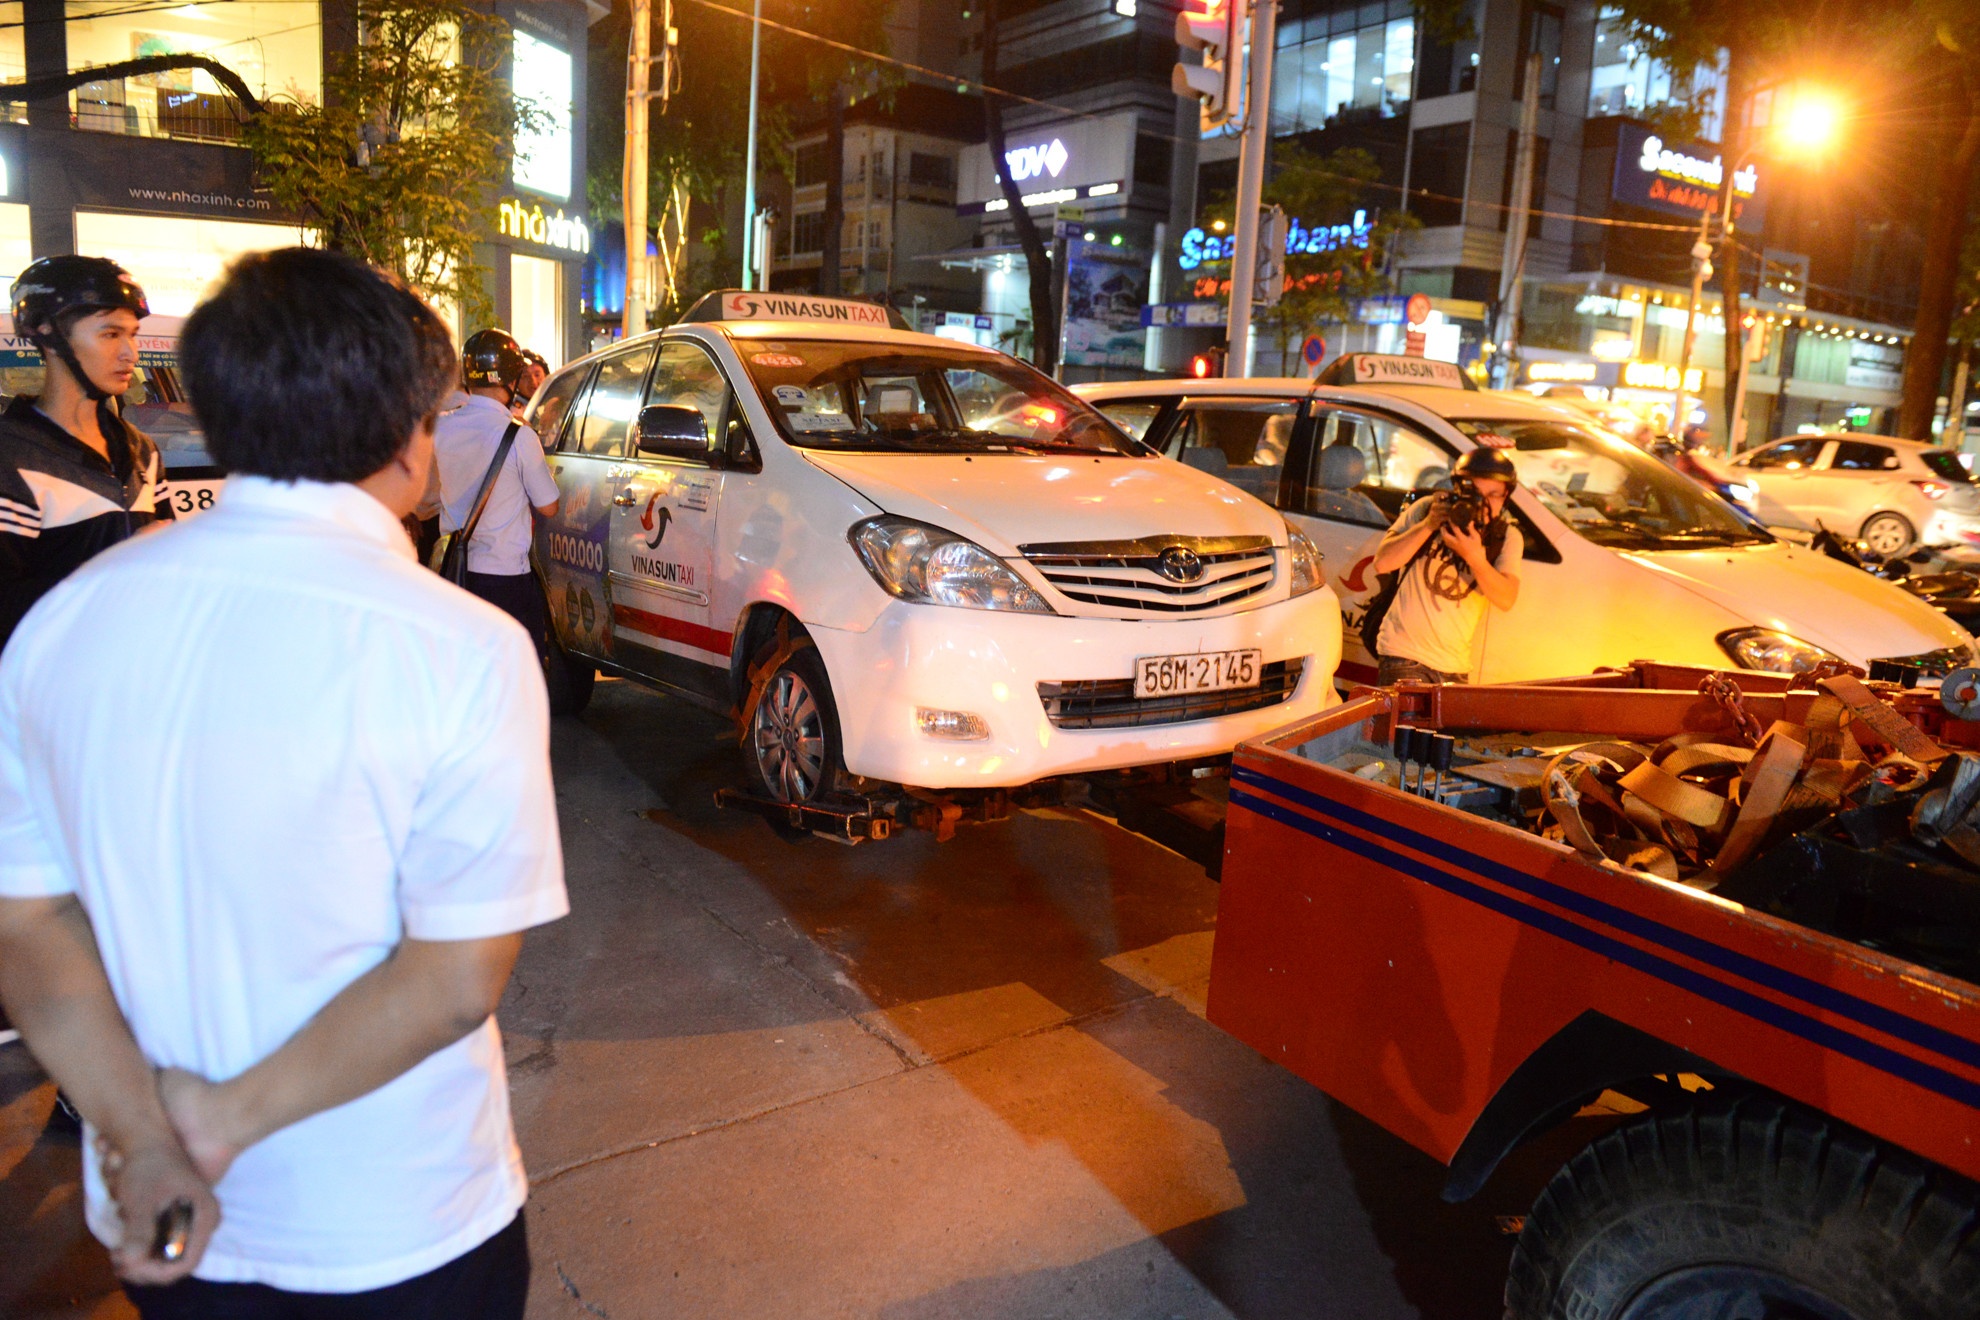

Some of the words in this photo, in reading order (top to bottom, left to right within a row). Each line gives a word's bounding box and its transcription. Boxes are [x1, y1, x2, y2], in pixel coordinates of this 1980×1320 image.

[1639, 135, 1758, 194] Sacombnk
[128, 187, 271, 210] www.nhaxinh.com
[550, 532, 604, 573] 1.000.000
